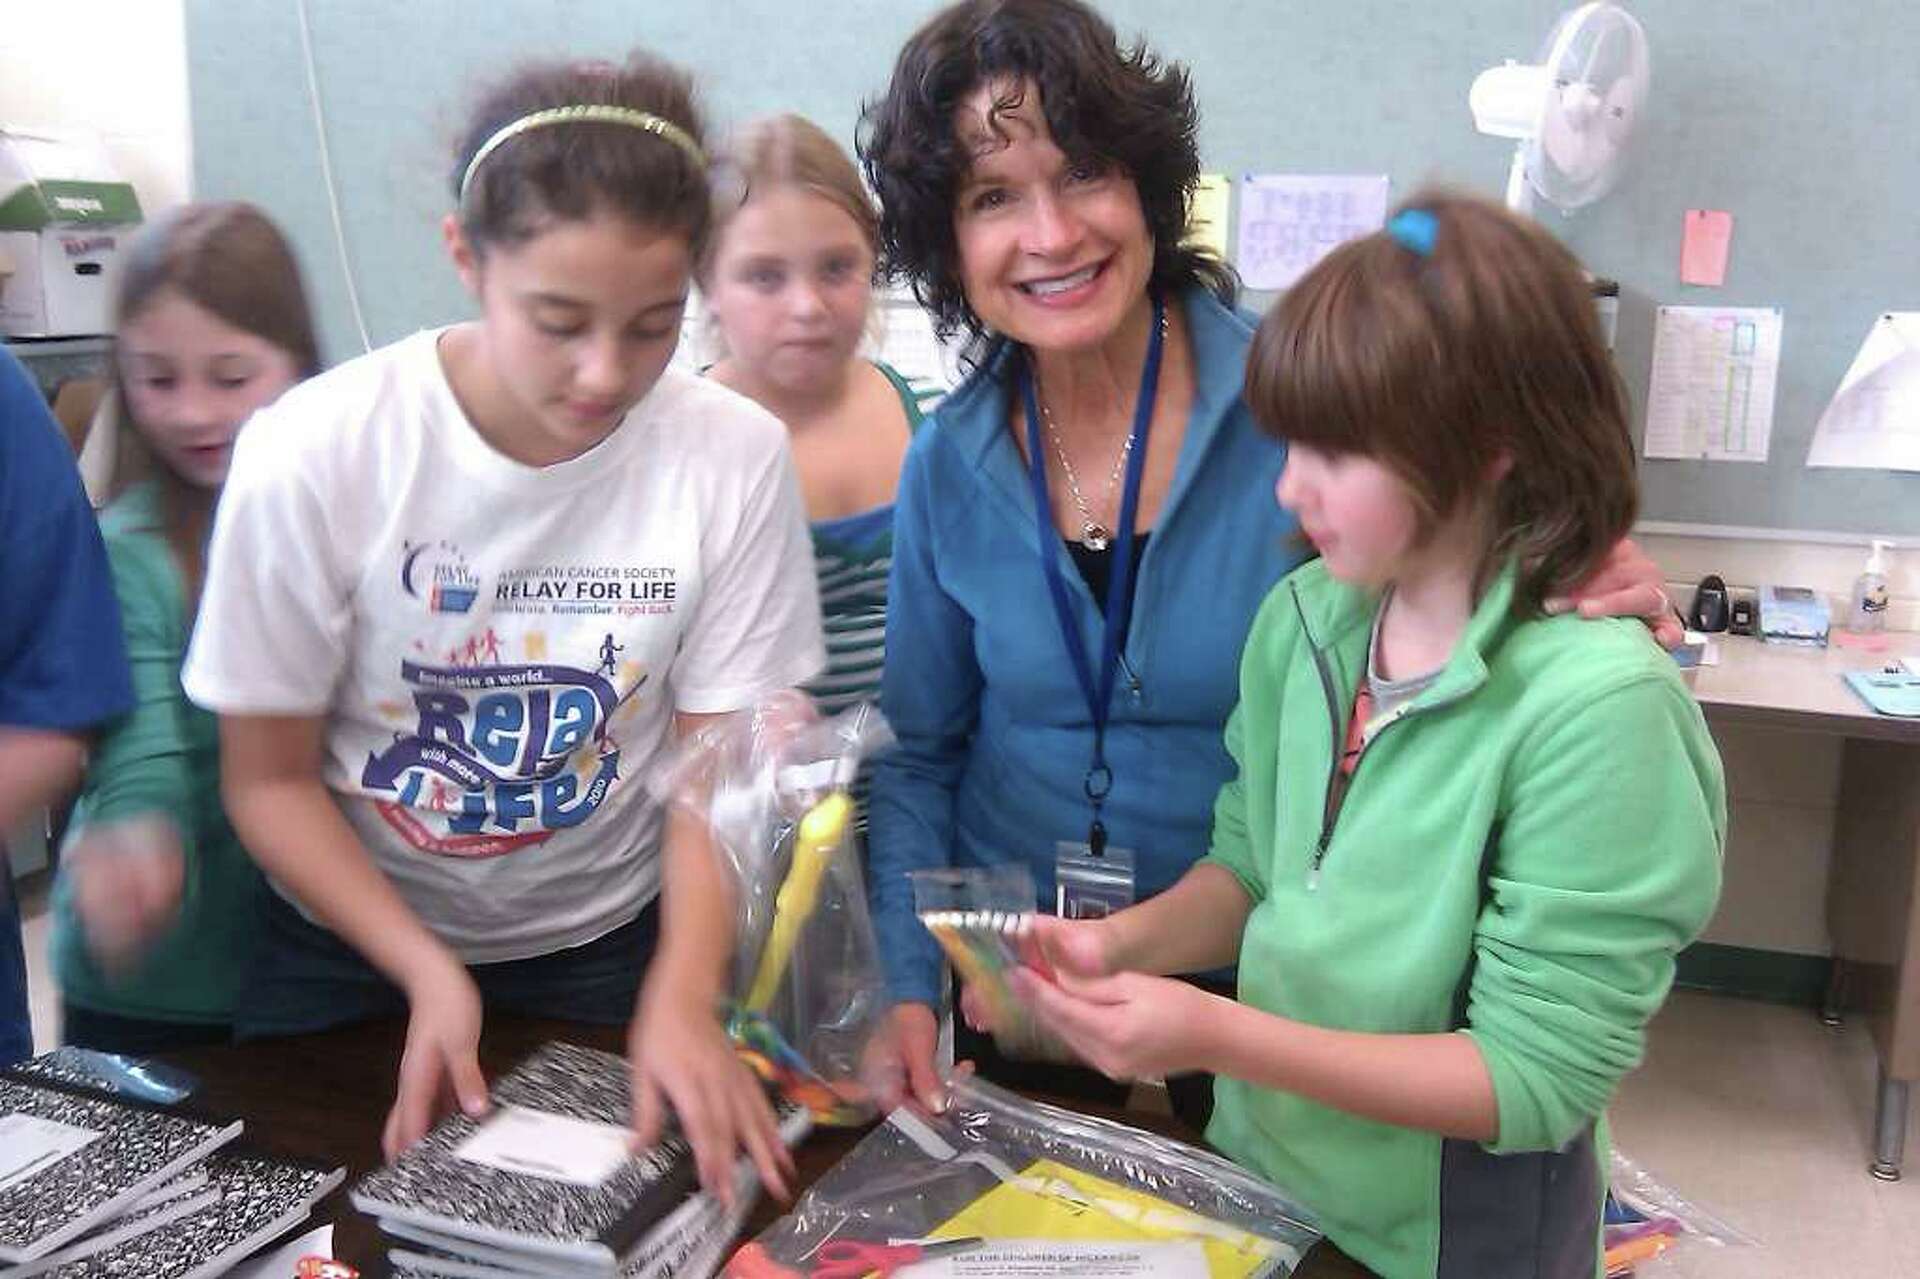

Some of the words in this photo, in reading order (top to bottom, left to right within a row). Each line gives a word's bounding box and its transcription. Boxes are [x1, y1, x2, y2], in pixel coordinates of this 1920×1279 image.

[568, 567, 620, 579] CANCER
[623, 567, 676, 579] SOCIETY
[496, 581, 568, 600] RELAY
[577, 582, 622, 599] FOR
[630, 582, 676, 599] LIFE
